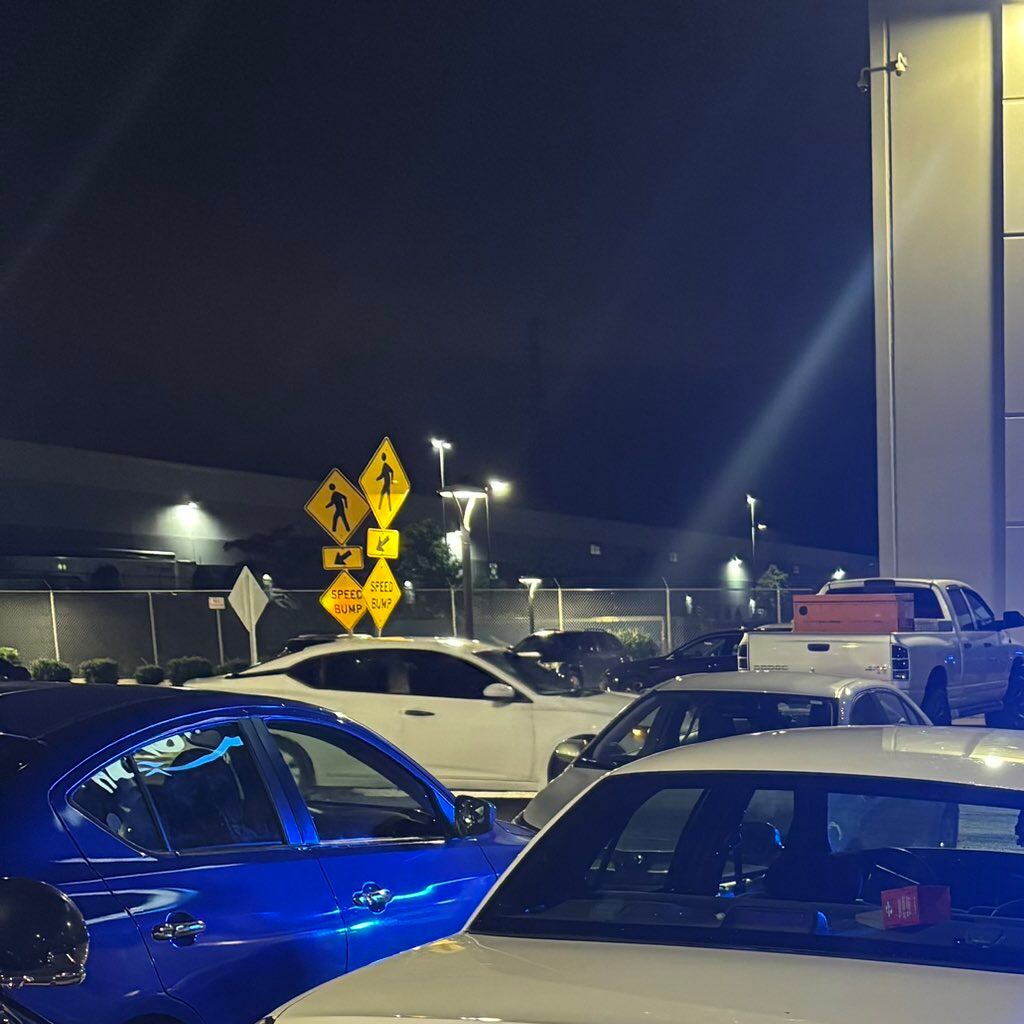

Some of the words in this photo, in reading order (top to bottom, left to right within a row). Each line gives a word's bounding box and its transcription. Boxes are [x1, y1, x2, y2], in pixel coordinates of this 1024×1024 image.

[371, 581, 393, 593] SPEED
[331, 589, 363, 600] SPEED
[371, 597, 392, 609] BUMP
[334, 604, 363, 614] BUMP
